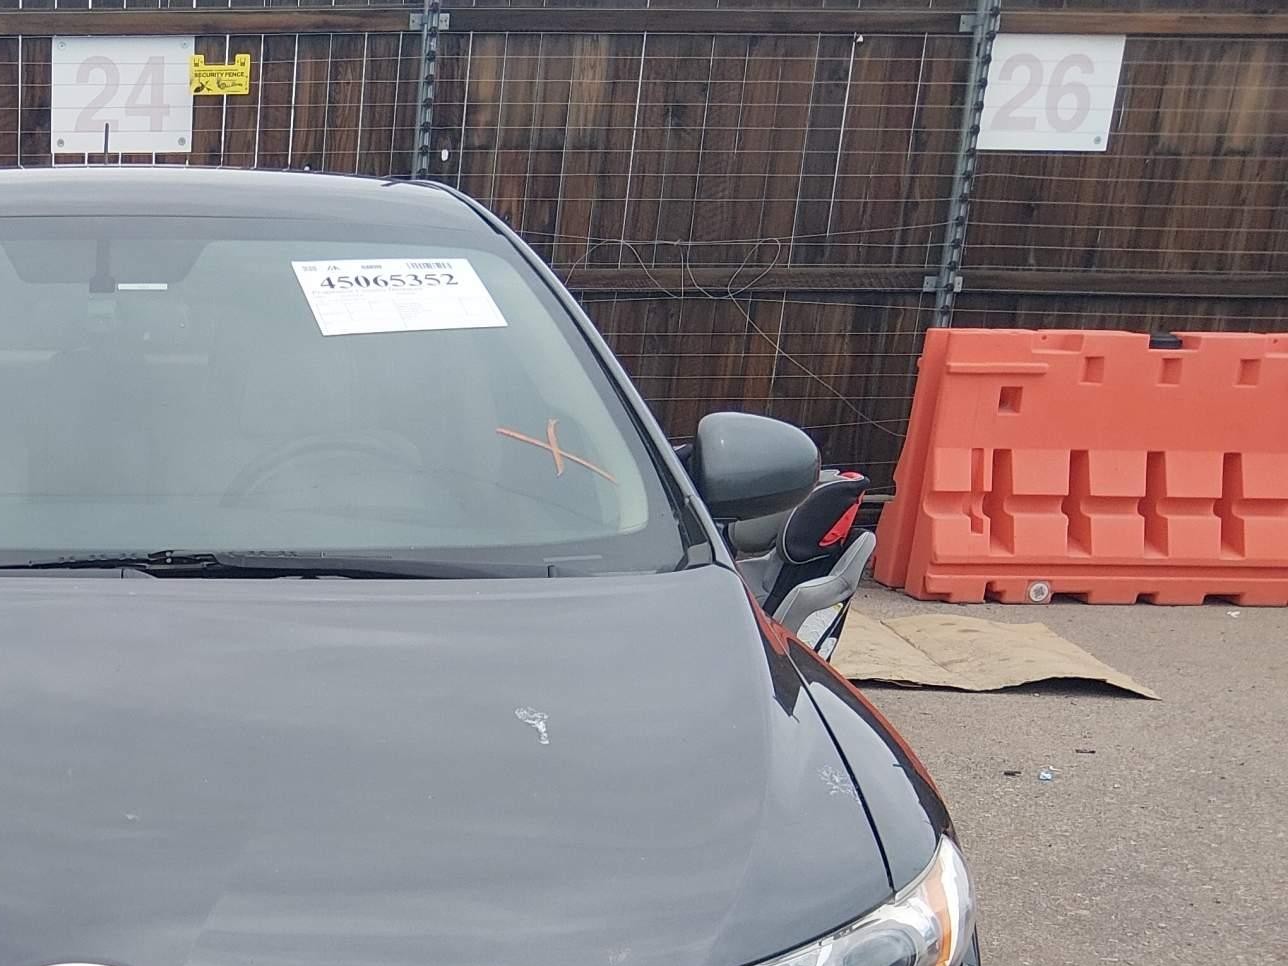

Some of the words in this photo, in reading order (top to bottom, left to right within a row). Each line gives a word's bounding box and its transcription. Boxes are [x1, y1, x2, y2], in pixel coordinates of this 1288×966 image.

[74, 55, 170, 133] 24
[990, 53, 1095, 133] 26
[320, 273, 459, 289] 45065352
